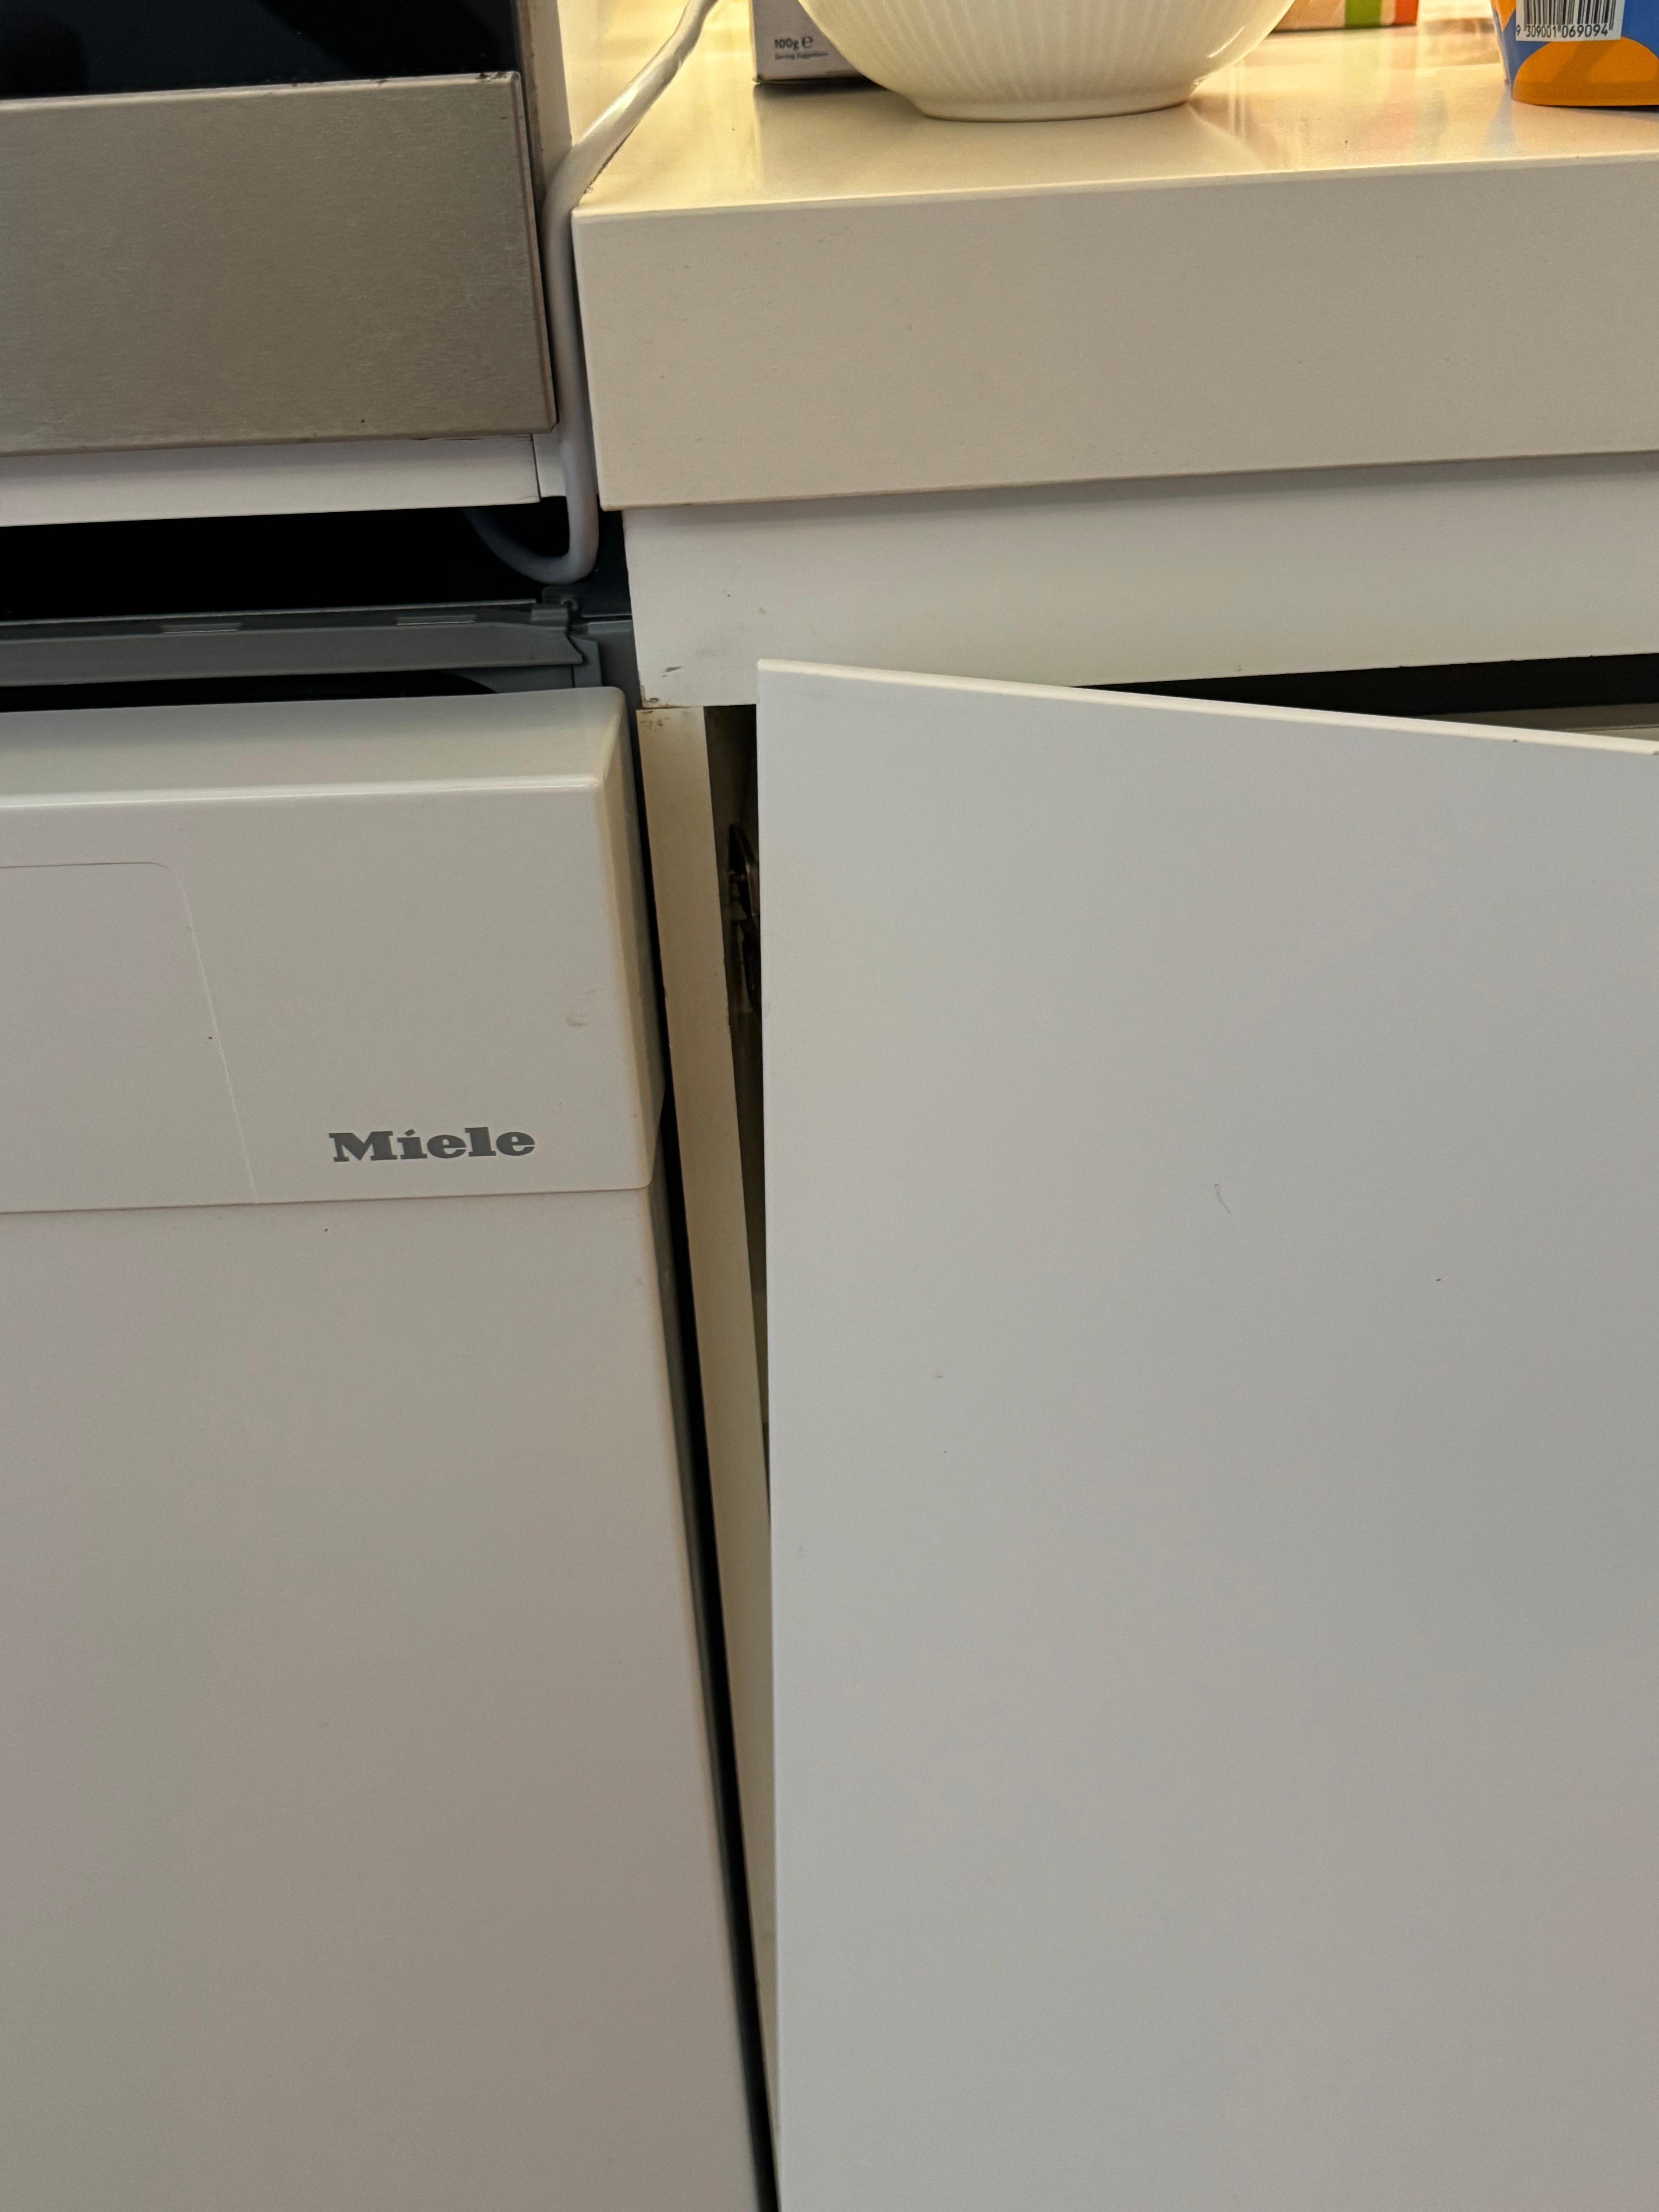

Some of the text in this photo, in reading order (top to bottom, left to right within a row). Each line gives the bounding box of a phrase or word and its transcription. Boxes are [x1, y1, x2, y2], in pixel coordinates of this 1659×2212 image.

[1516, 24, 1608, 38] 9 309001 069094
[775, 38, 799, 50] 100g
[328, 1127, 535, 1162] Miele
